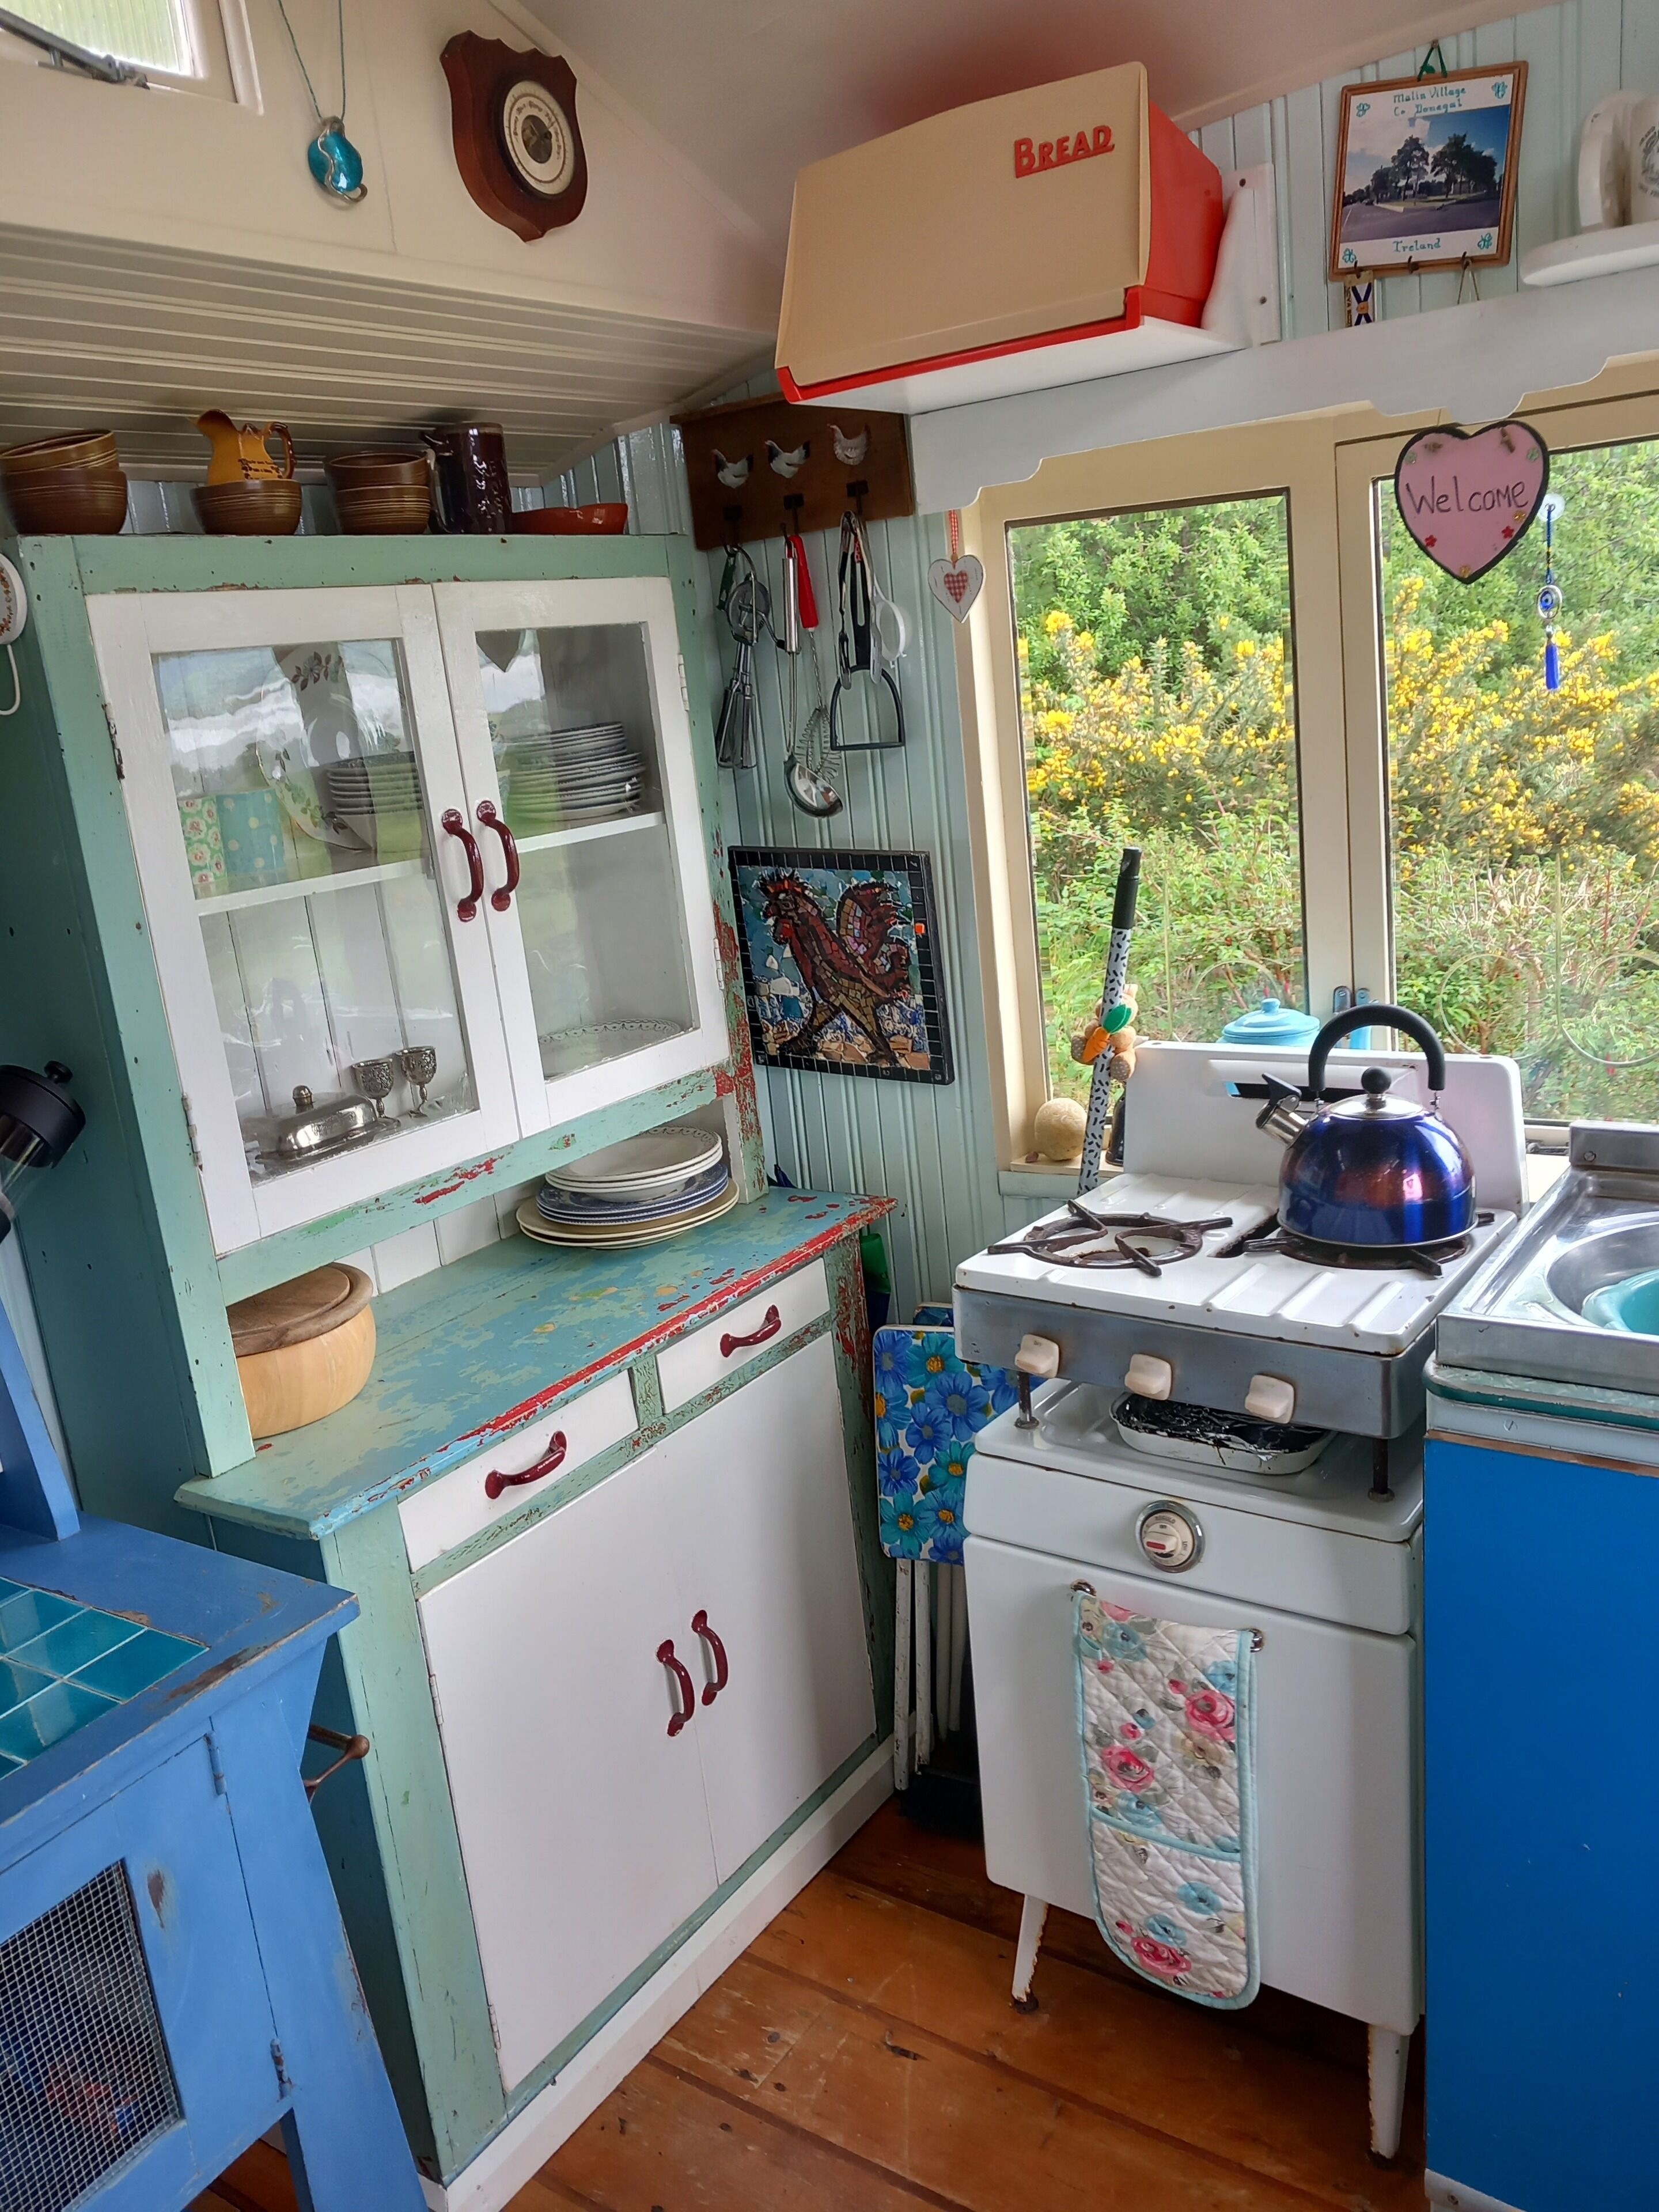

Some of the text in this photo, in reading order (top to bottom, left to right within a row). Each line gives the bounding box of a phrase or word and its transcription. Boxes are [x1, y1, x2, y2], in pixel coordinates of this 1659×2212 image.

[1393, 86, 1466, 103] Malin Village
[1415, 98, 1463, 117] Donegal
[1014, 124, 1115, 179] BREAD
[1393, 237, 1441, 252] Ireland
[1406, 475, 1528, 514] Welcome
